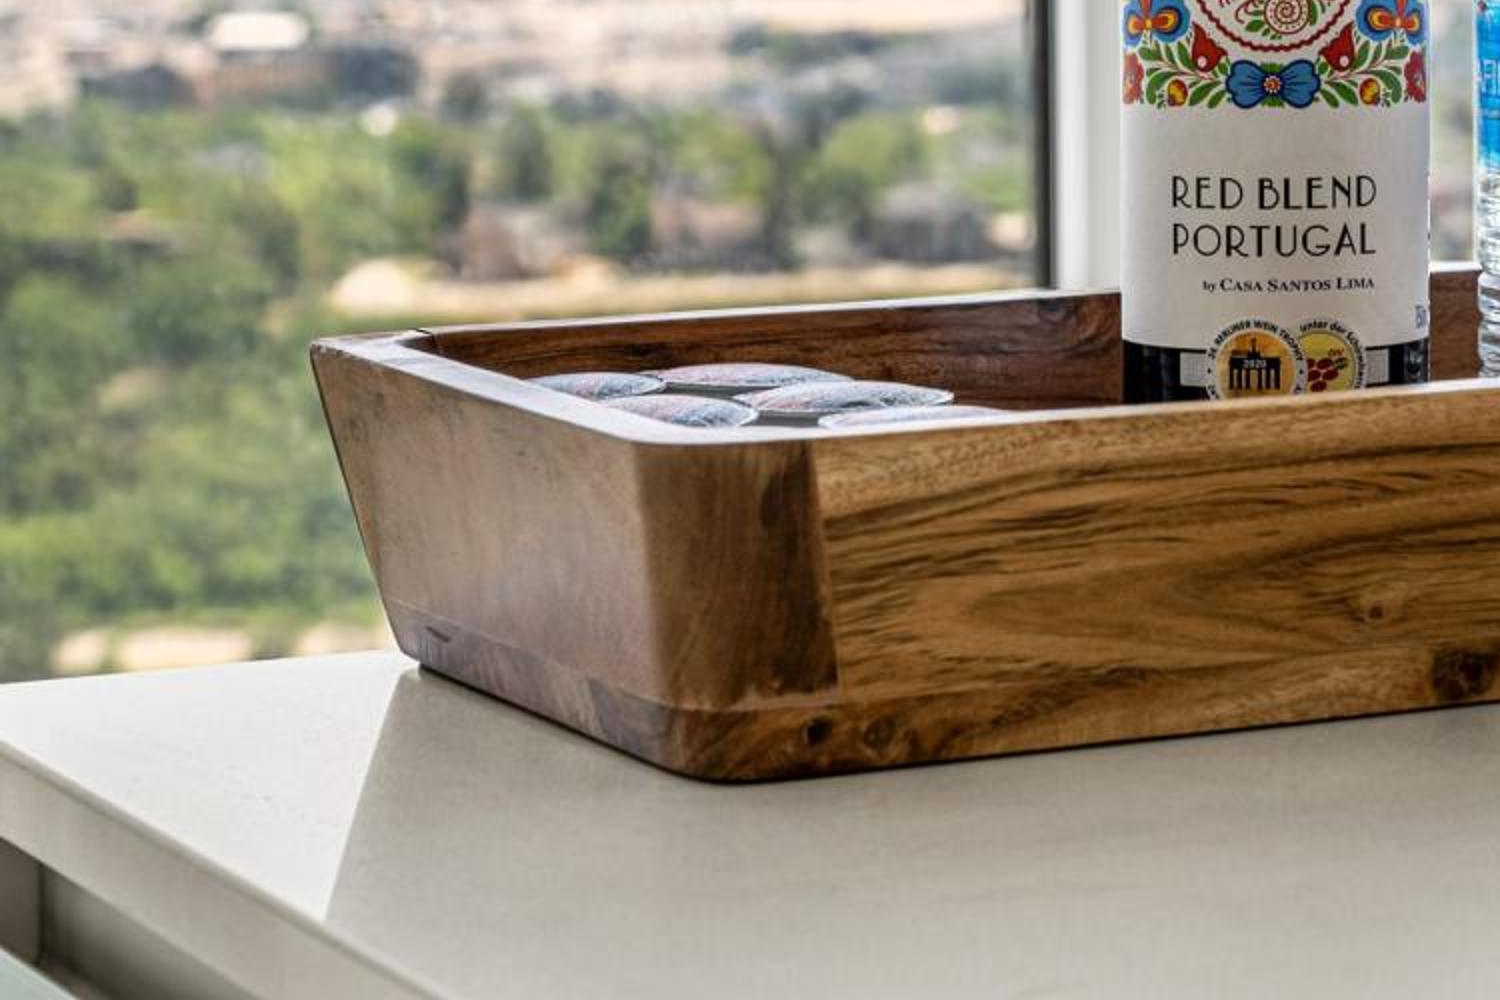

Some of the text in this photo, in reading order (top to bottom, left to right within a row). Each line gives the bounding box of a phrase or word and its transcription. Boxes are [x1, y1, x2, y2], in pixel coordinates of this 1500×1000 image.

[1171, 174, 1378, 210] RED BLEND
[1171, 222, 1377, 258] PORTUGAL
[1202, 279, 1215, 293] by
